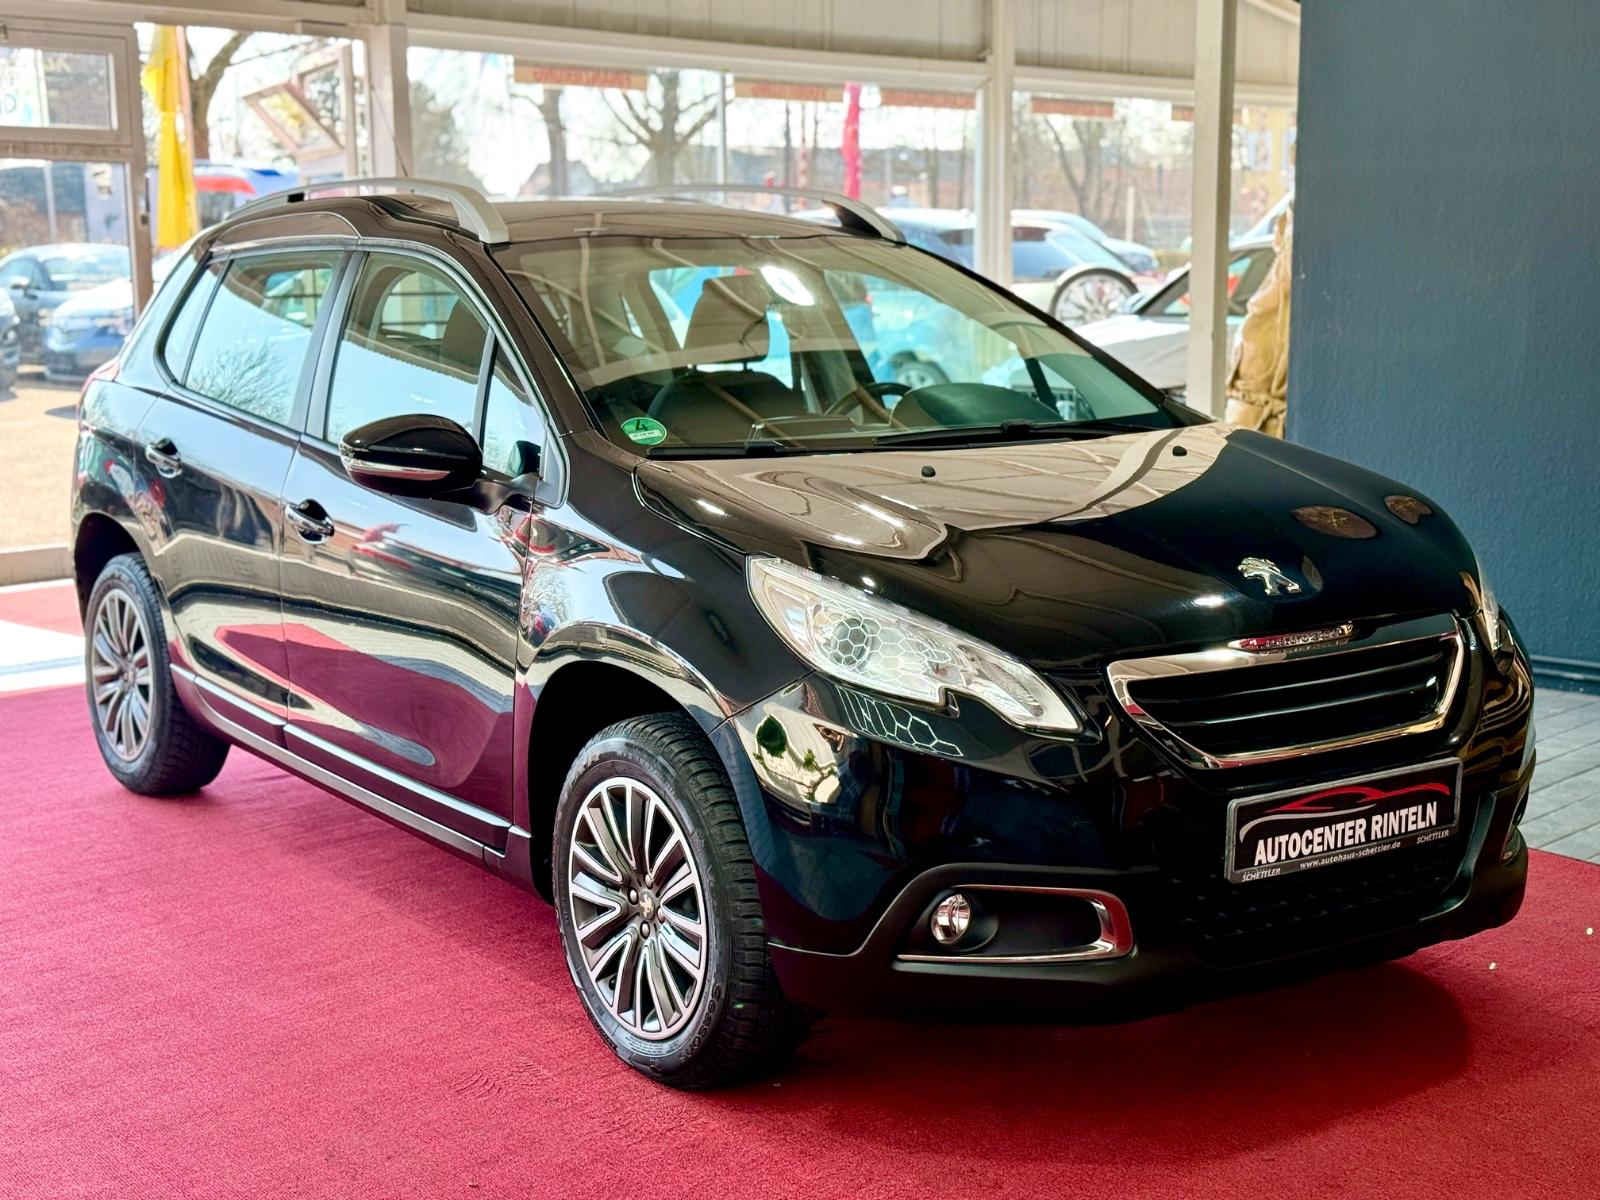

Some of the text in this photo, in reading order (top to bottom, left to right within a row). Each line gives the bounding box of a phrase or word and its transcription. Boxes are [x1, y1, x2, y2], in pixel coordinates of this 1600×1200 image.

[635, 419, 648, 431] 4
[1254, 801, 1437, 866] AUTOCENTER RINTELN
[1416, 829, 1450, 844] SCHETTLER
[1300, 841, 1401, 869] www.autohaus-schettler.de
[1241, 867, 1281, 883] SCHETTLER
